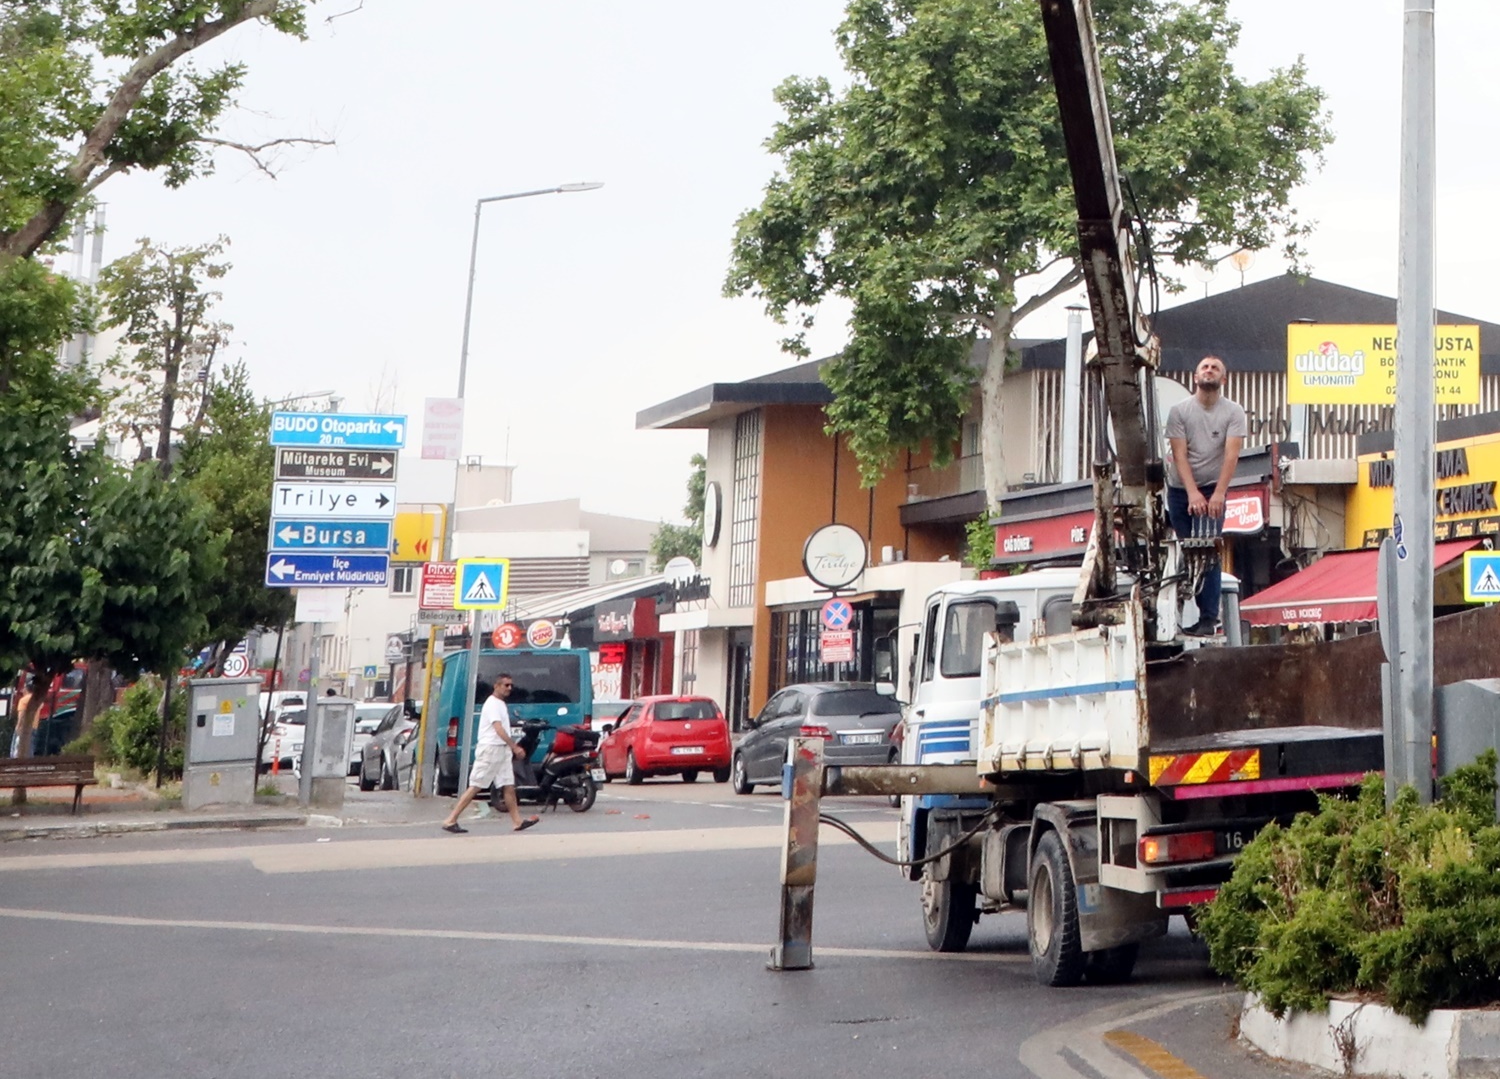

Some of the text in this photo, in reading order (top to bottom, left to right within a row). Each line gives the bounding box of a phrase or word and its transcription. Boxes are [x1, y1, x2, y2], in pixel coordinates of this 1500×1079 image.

[1294, 347, 1366, 377] uludağ
[1433, 358, 1466, 367] ANTIK
[1449, 386, 1461, 395] 44
[274, 416, 382, 437] BUDO Otoparkı
[320, 434, 332, 444] 20
[282, 451, 369, 467] Mütareke Evi
[305, 466, 346, 477] Museum
[279, 488, 357, 511] Trilye
[1444, 481, 1498, 514] EKMEK
[1225, 502, 1249, 519] ecati
[1239, 512, 1260, 526] Usta
[303, 525, 366, 544] Bursa
[332, 556, 350, 571] İlçe
[429, 565, 456, 575] DİKKA
[294, 569, 385, 584] Emniyet Müdürlüğü
[420, 611, 456, 622] Belediye
[224, 659, 242, 672] 30
[1225, 831, 1243, 849] 16
